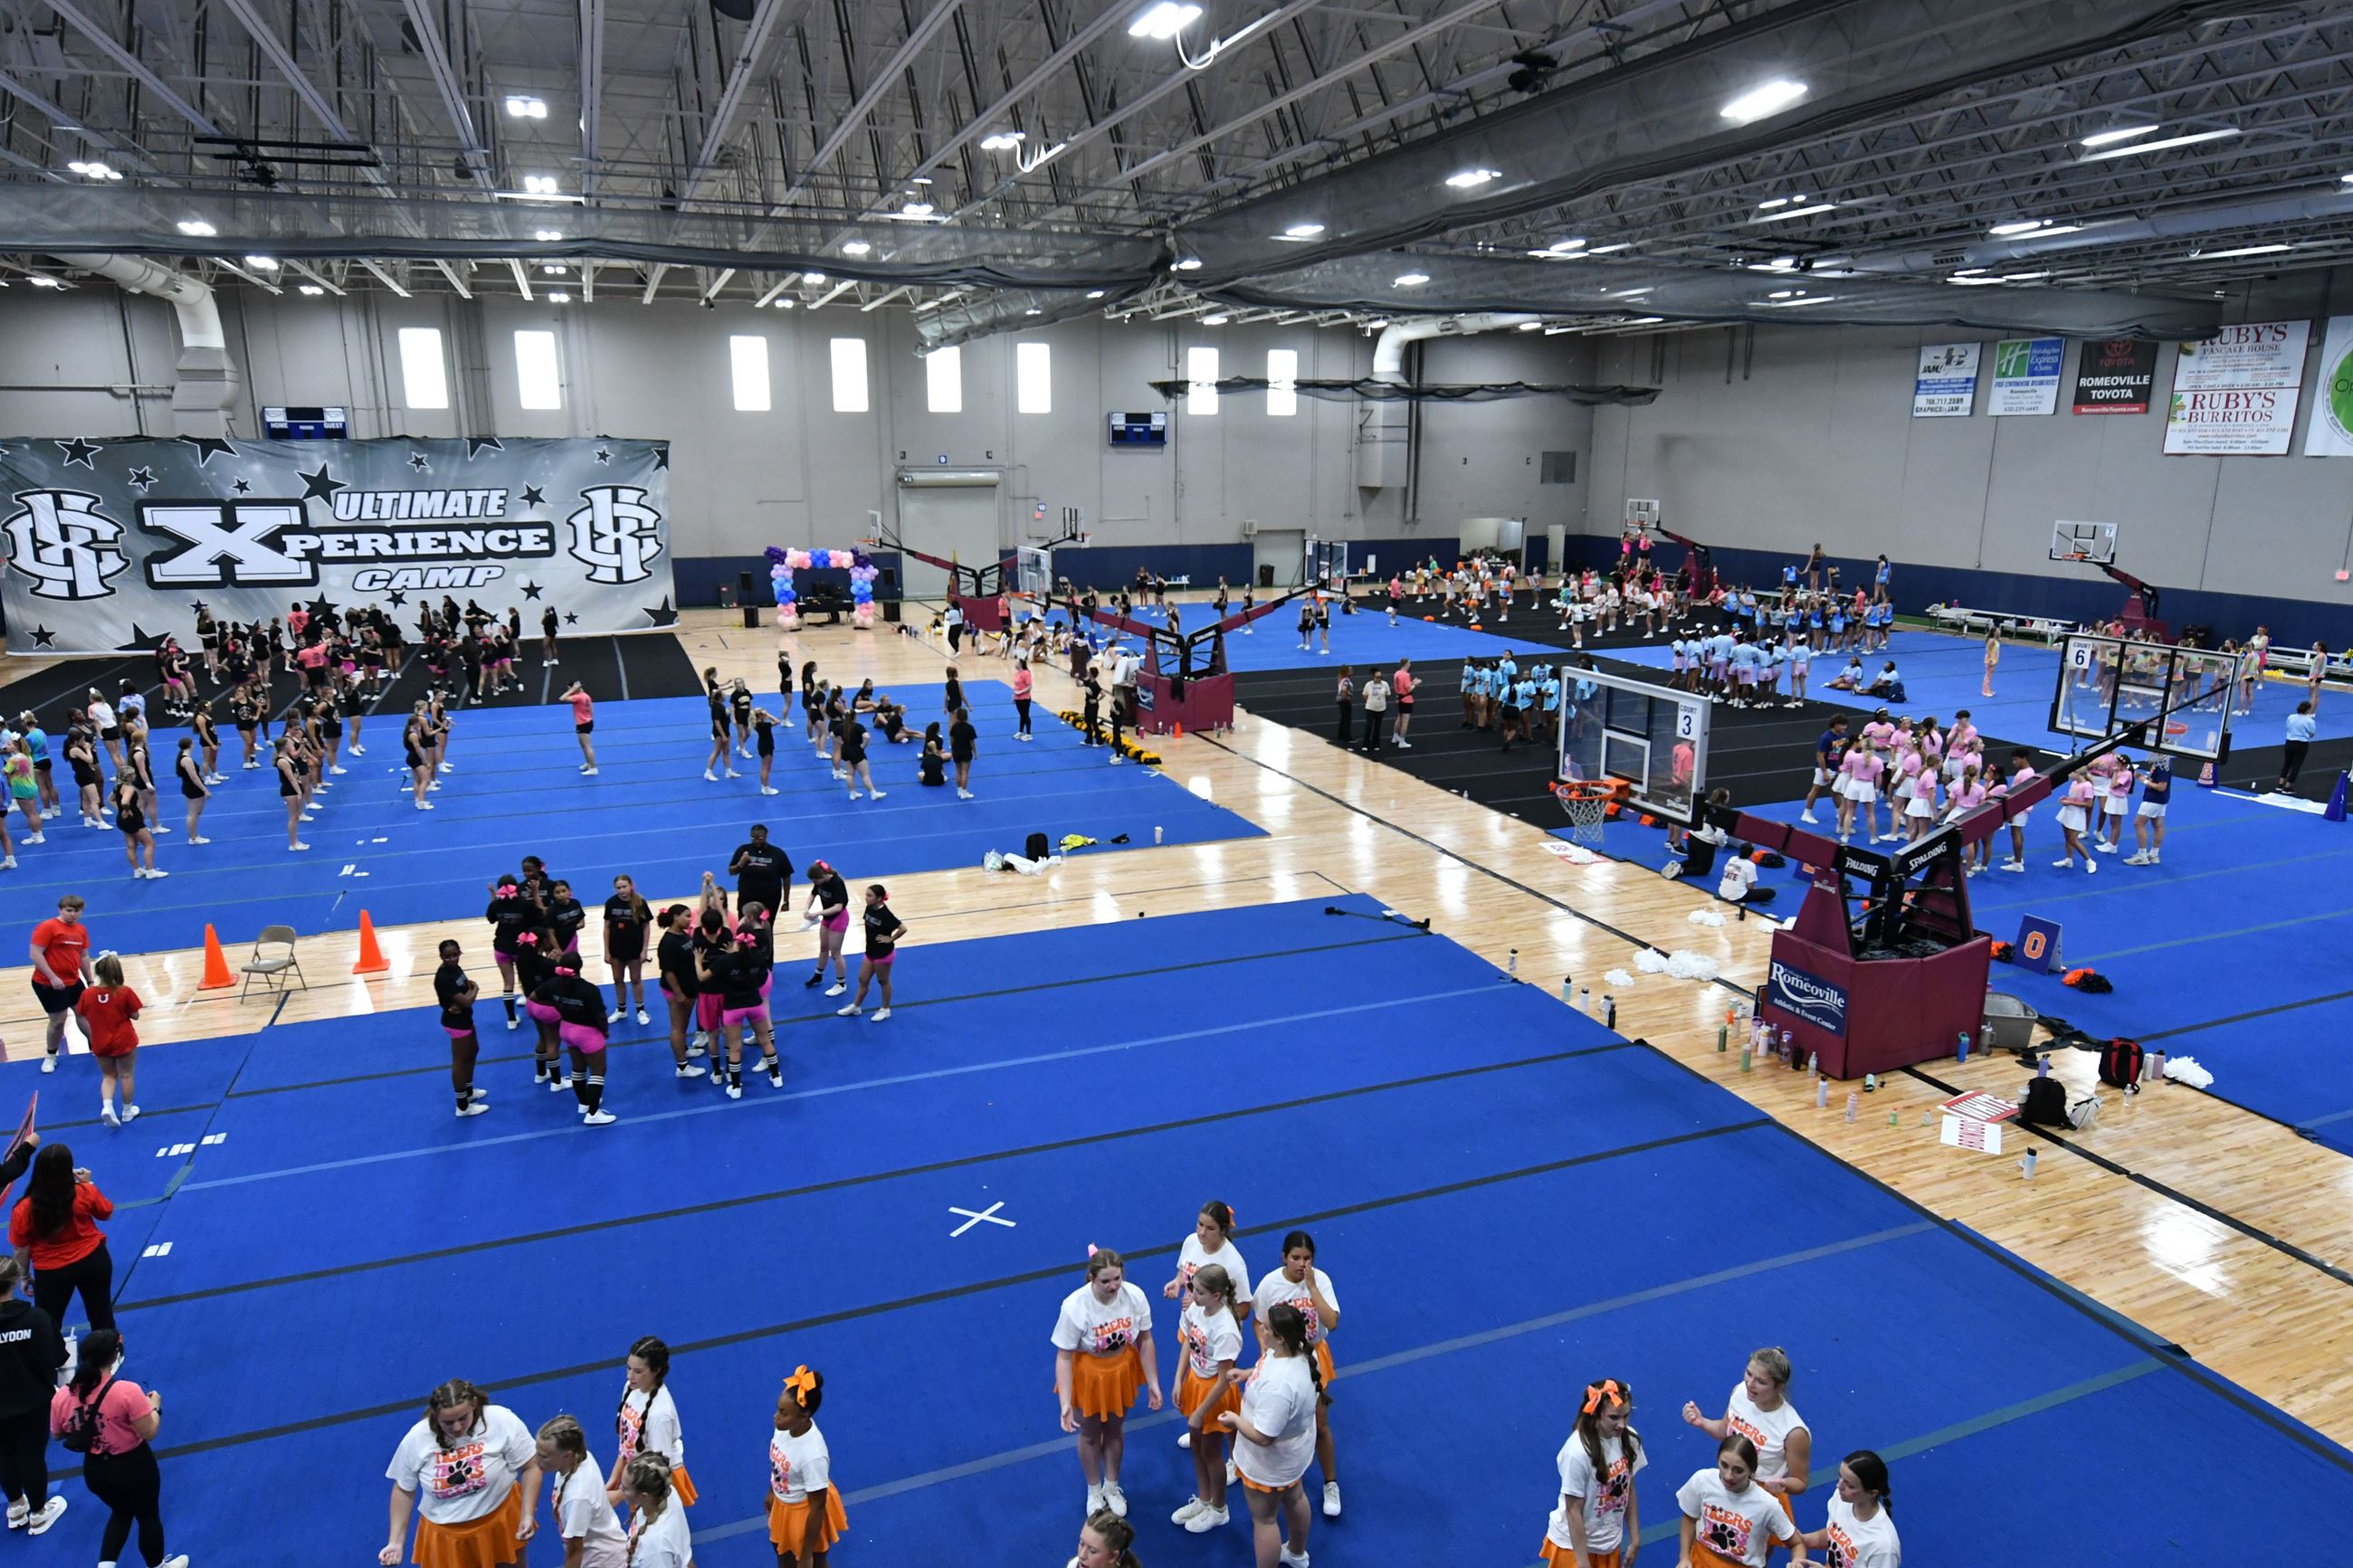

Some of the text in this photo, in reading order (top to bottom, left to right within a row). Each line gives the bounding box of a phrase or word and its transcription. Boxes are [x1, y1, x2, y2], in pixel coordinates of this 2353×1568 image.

[2203, 343, 2281, 356] PANCAKE HOUSE
[1921, 364, 1943, 374] JAM!
[2030, 355, 2060, 366] Express
[2100, 356, 2135, 367] TOYOTA
[2079, 375, 2151, 387] ROMEOVILLE
[2091, 388, 2134, 399] TOYOTA
[2190, 391, 2276, 411] RUBY'S
[2186, 410, 2273, 423] BURRITOS
[334, 489, 509, 521] ULTIMATE
[352, 565, 505, 592] CAMP
[2075, 649, 2085, 666] 6
[1680, 704, 1698, 715] COURT
[1682, 715, 1691, 736] 3
[1909, 841, 1948, 871] SPALDING
[1770, 962, 1845, 1008] Romeoville
[1773, 997, 1796, 1012] Athletic
[1801, 1009, 1817, 1022] Event
[1816, 1017, 1836, 1031] Center
[1091, 1316, 1131, 1337] TIGERS
[1730, 1413, 1767, 1447] IGERS
[434, 1442, 485, 1464] TIGERS
[1703, 1502, 1753, 1534] TIGERS
